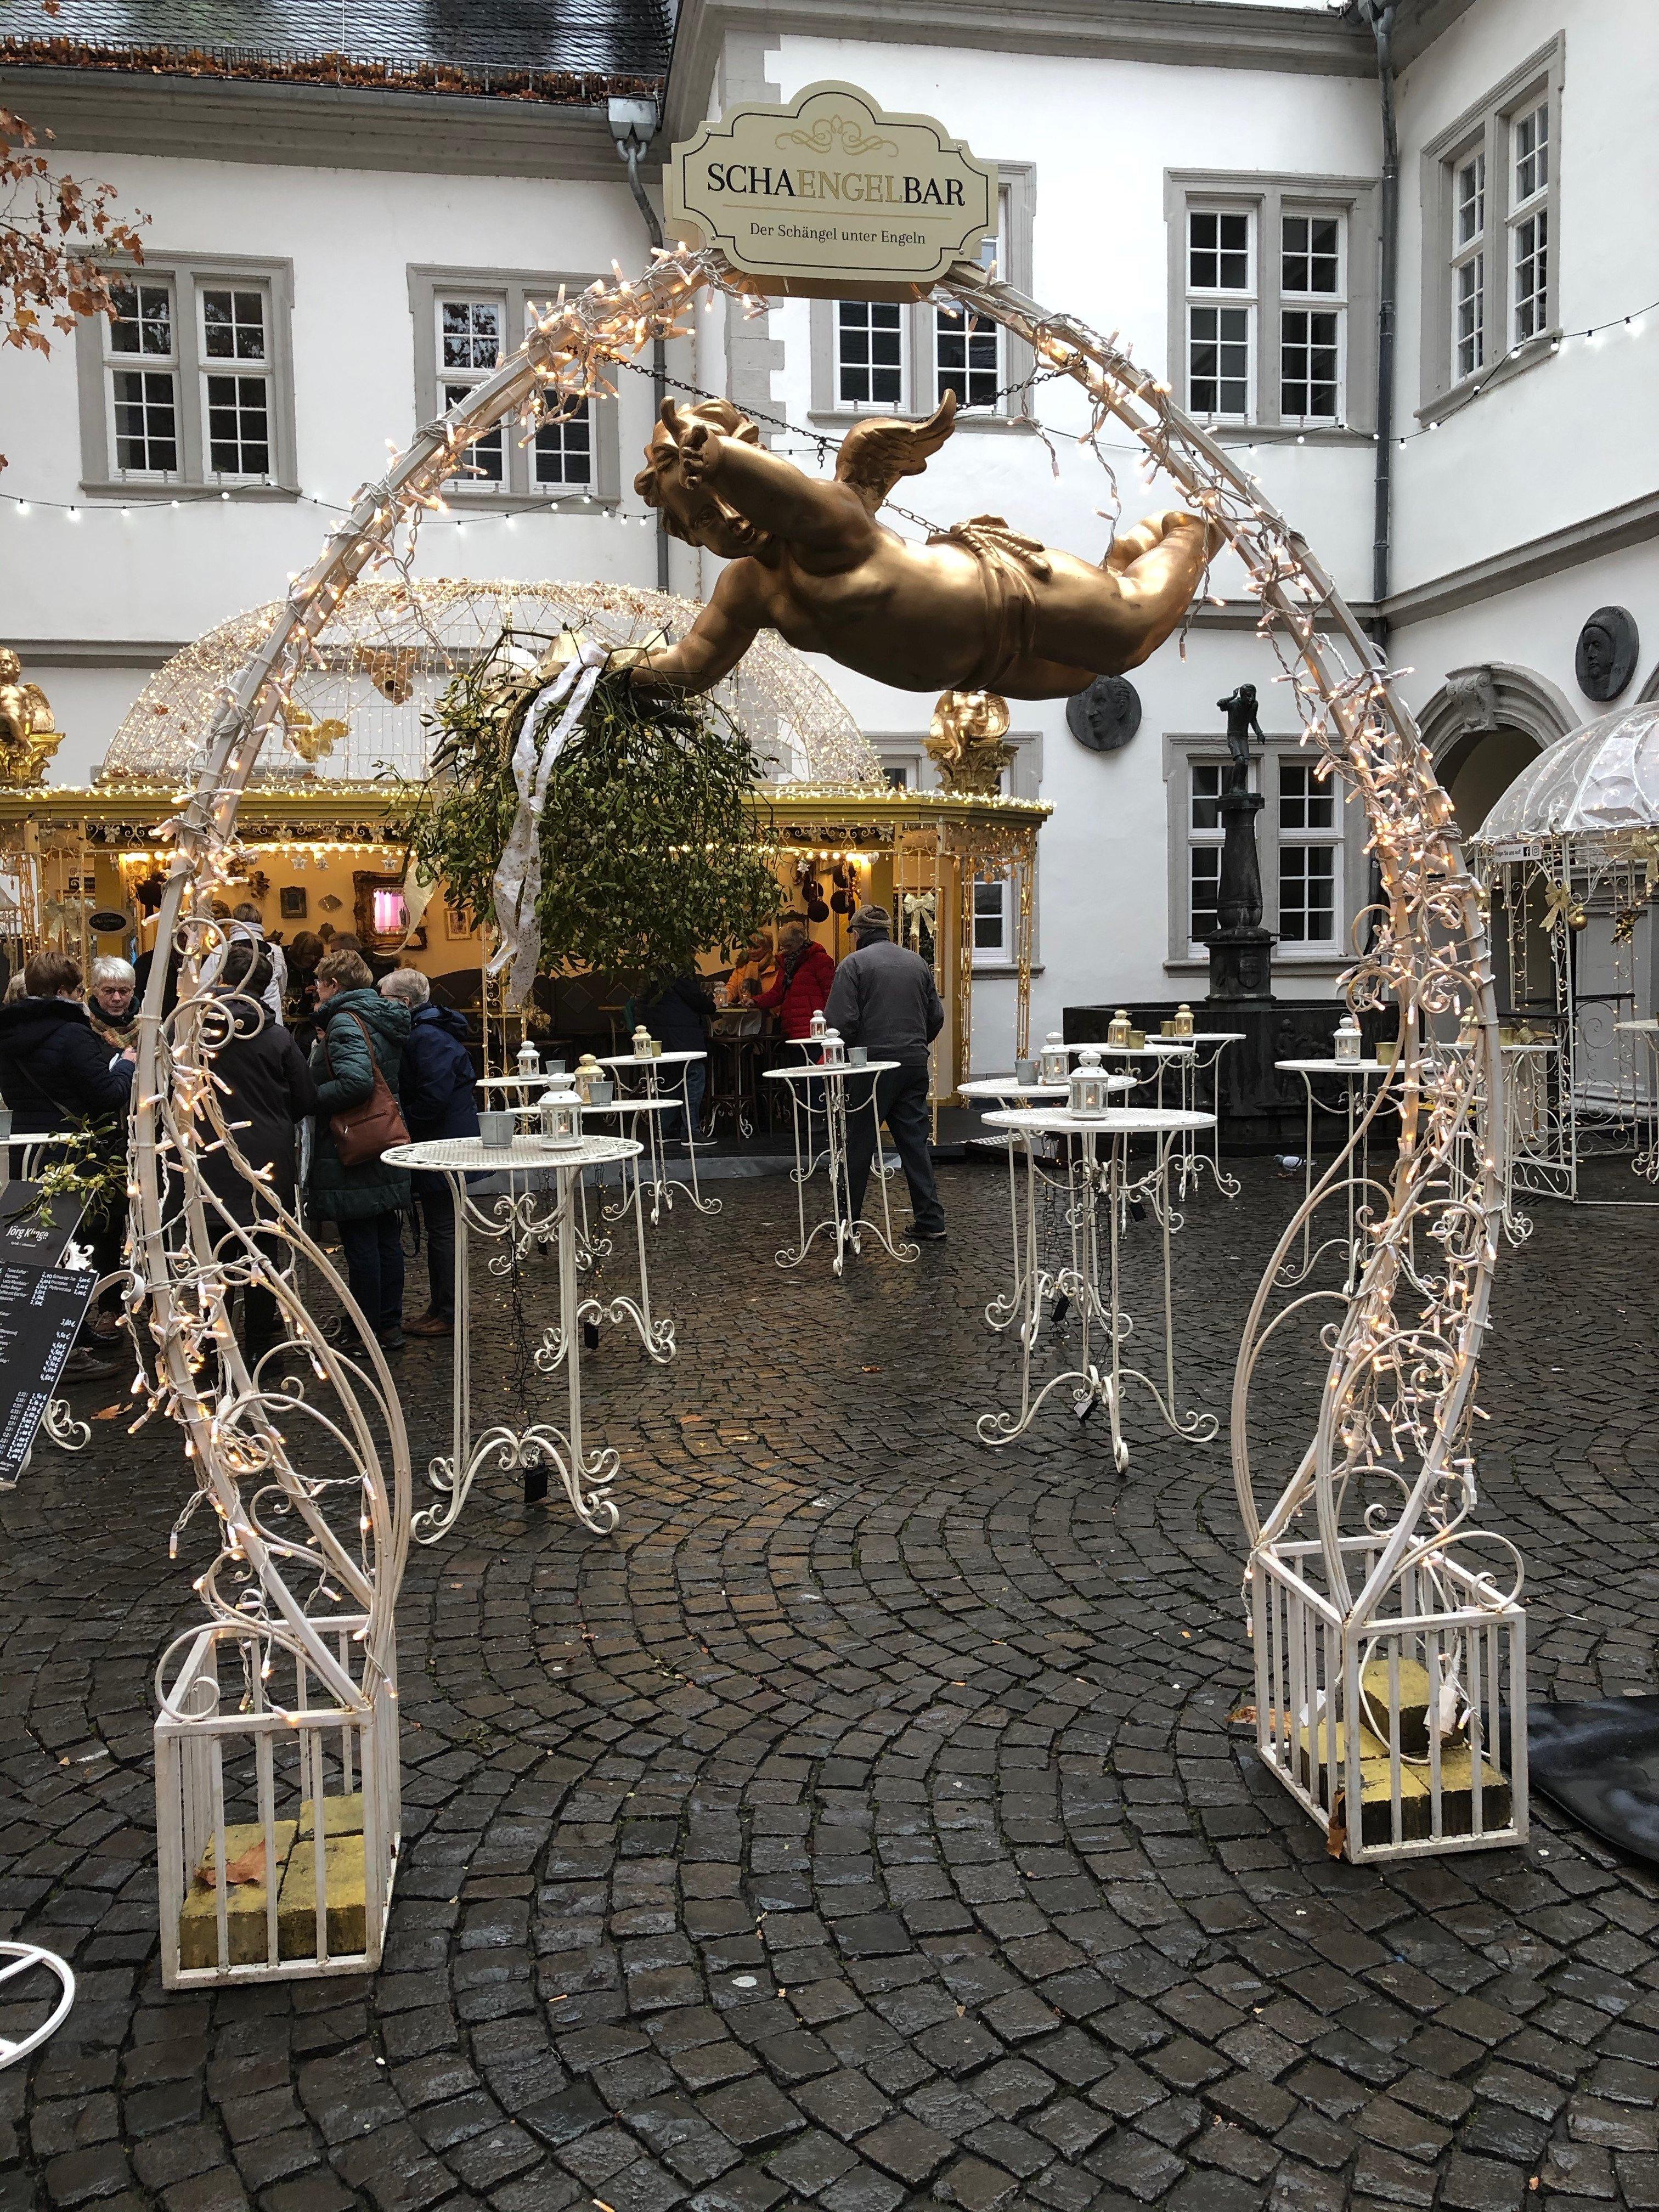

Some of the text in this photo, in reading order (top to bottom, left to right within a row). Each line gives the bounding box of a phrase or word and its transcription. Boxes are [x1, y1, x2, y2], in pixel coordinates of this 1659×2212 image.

[707, 163, 966, 206] SCHAENGELBAR
[749, 222, 926, 247] Der Schängel unter Engeln
[5, 1225, 25, 1239] Jörg
